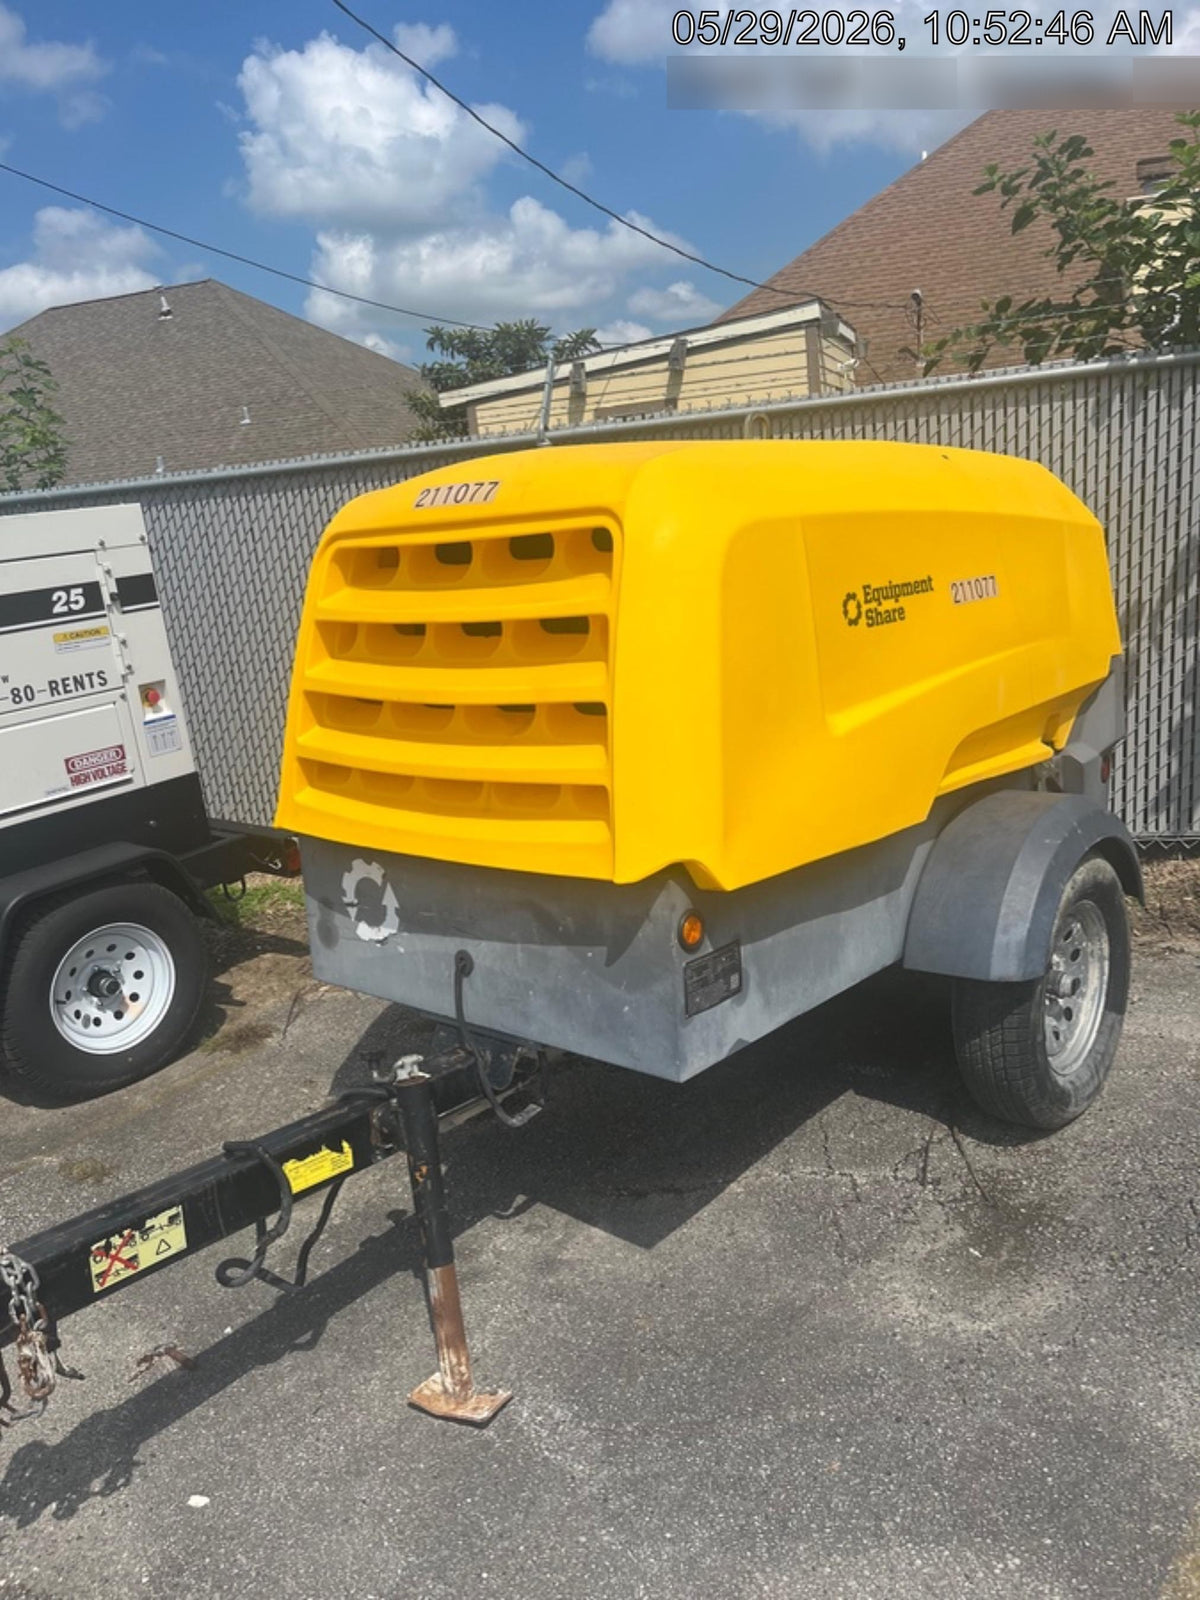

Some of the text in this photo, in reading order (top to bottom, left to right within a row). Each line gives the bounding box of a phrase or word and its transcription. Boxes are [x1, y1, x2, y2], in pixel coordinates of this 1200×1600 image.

[414, 481, 499, 508] 211077
[52, 587, 86, 614] 25
[862, 575, 934, 606] Equipment
[951, 576, 997, 603] 211077
[865, 606, 906, 628] Share
[69, 628, 101, 640] CAUTION
[75, 748, 117, 770] DANGER
[70, 762, 128, 787] HIGH VOLTAGE
